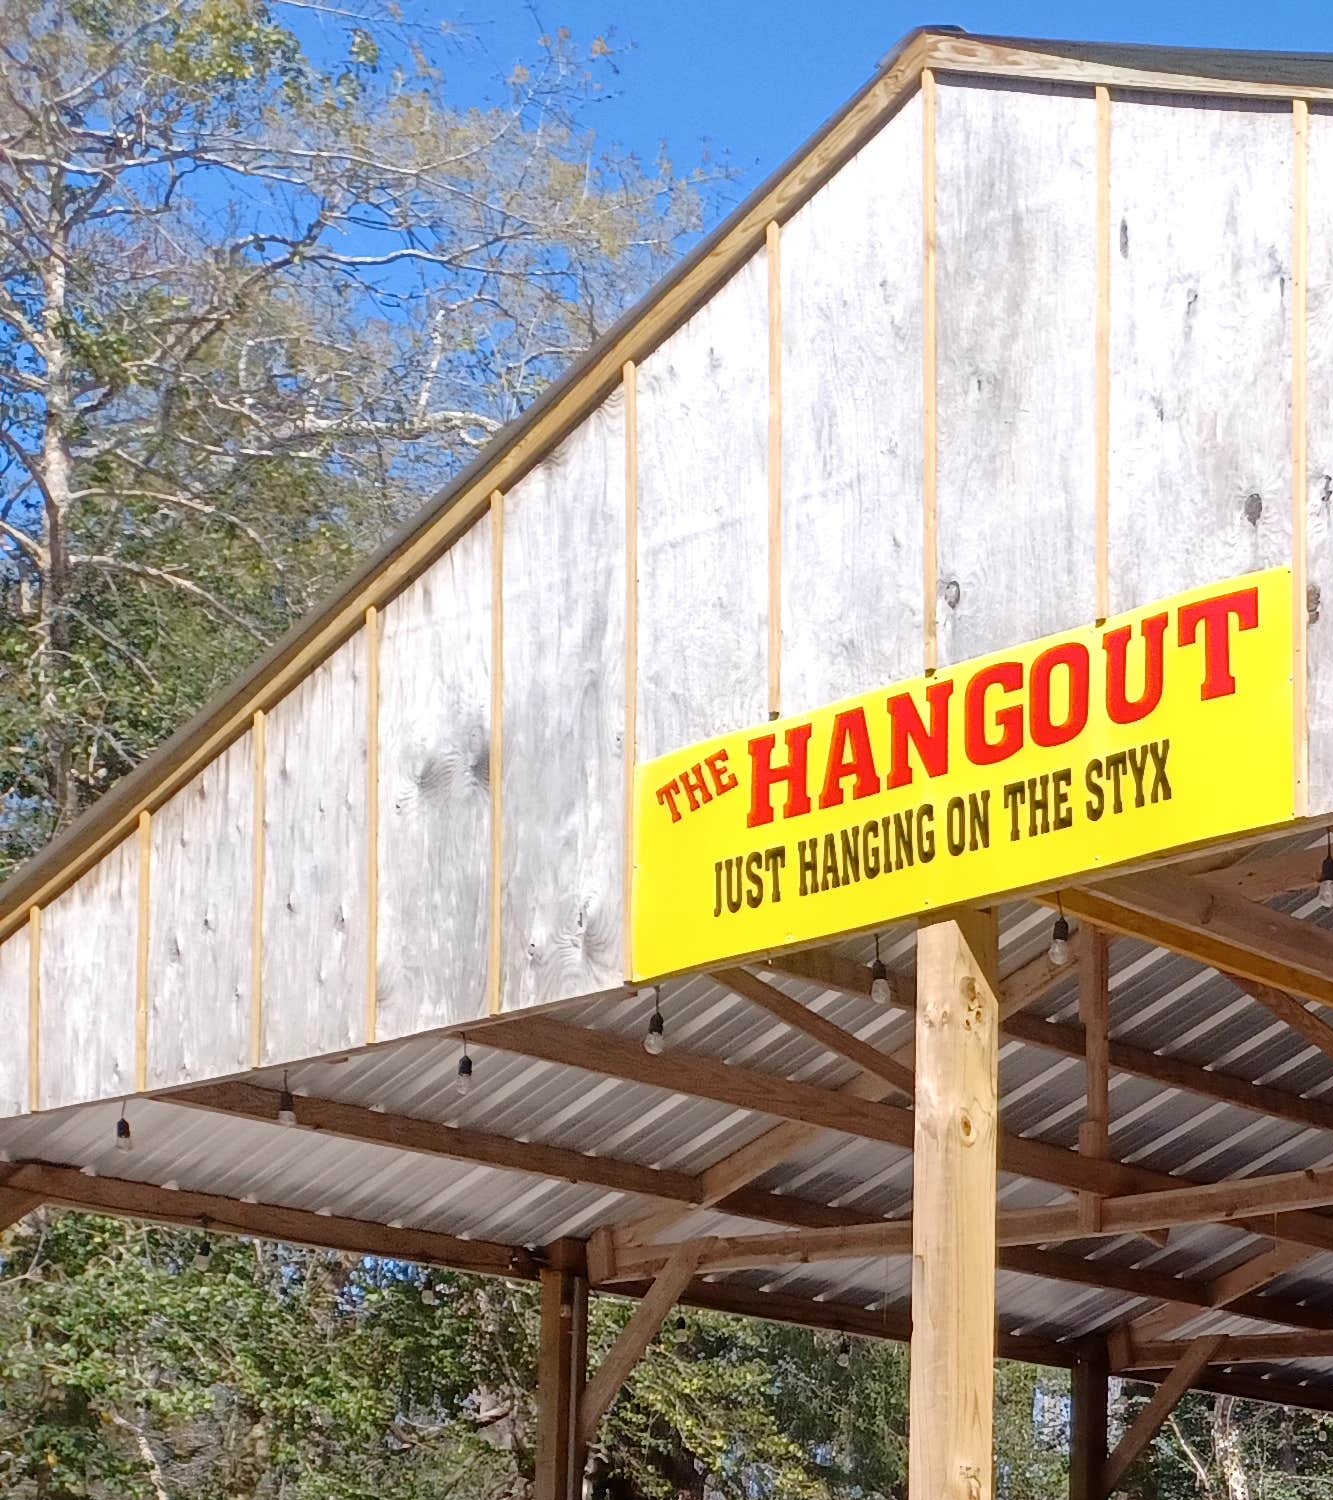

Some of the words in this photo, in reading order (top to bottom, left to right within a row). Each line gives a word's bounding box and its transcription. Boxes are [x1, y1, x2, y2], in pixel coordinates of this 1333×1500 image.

[656, 749, 739, 824] THE
[746, 587, 1259, 828] HANGOUT
[714, 846, 786, 917] JUST
[797, 803, 936, 897] HANGING
[946, 790, 991, 857] ON
[1003, 767, 1073, 842] THE
[1085, 738, 1172, 822] STYX
